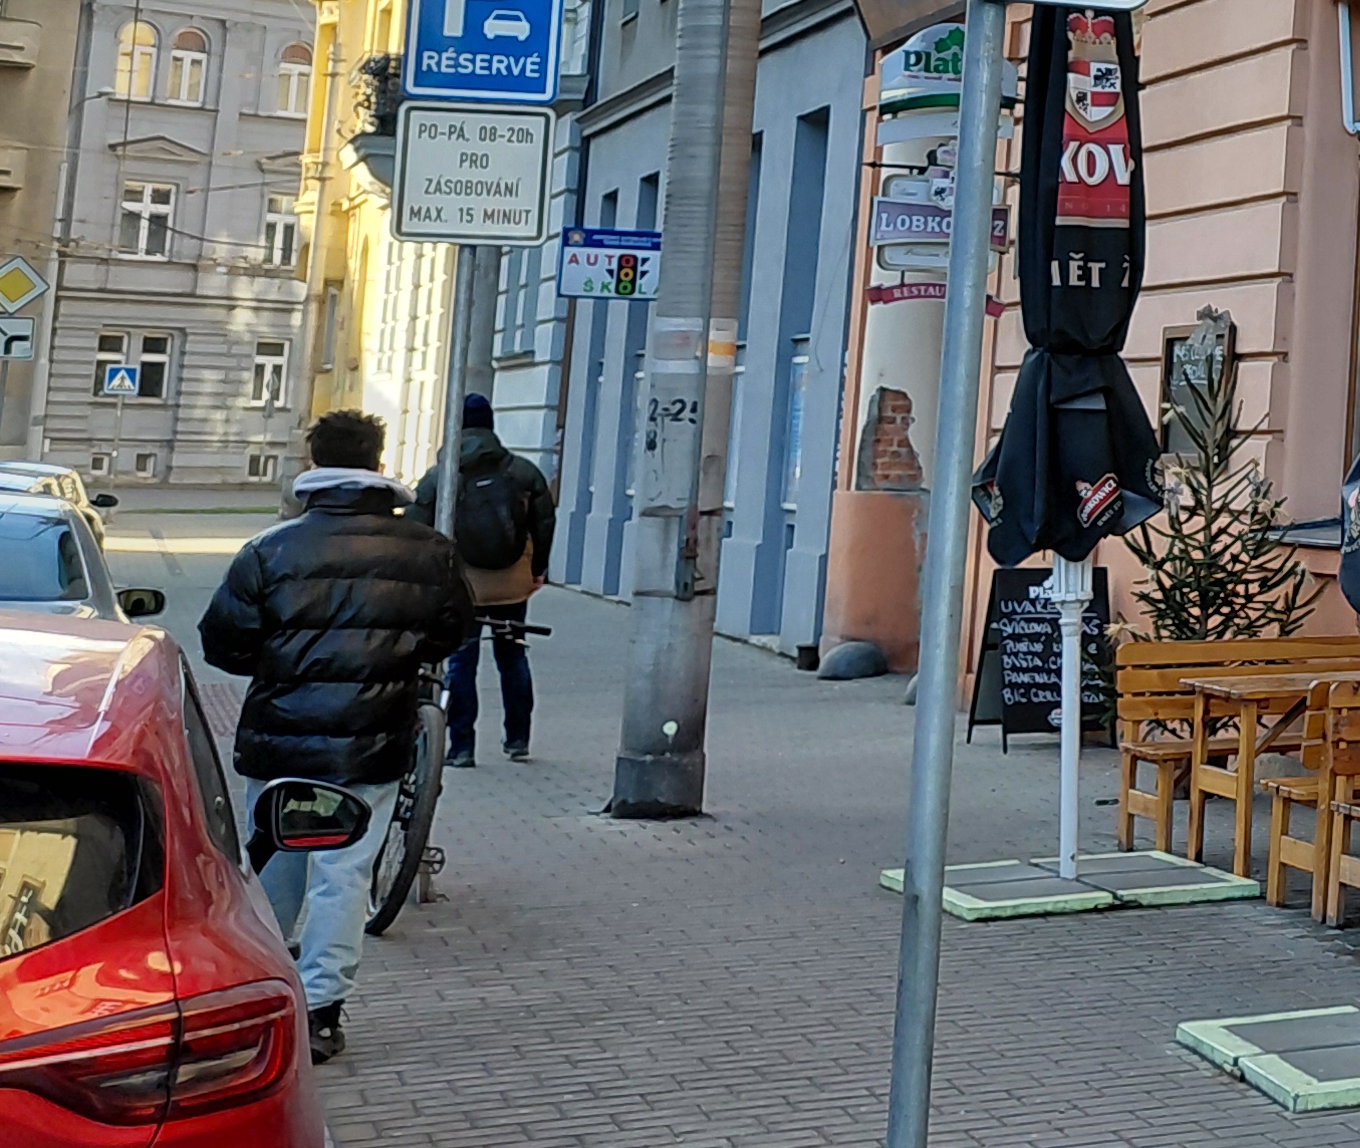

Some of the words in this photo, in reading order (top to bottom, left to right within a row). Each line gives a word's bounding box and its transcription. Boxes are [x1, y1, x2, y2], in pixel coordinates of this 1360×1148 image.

[421, 47, 541, 78] RÉSERVÉ
[903, 48, 962, 74] Plat
[478, 125, 534, 144] 08-20h
[458, 152, 490, 169] PRO
[423, 174, 522, 198] ZÁSOBOVÁNÍ
[408, 204, 448, 223] MAX.
[458, 207, 475, 224] 15
[482, 208, 532, 226] MINUT
[893, 282, 946, 299] RESTAU
